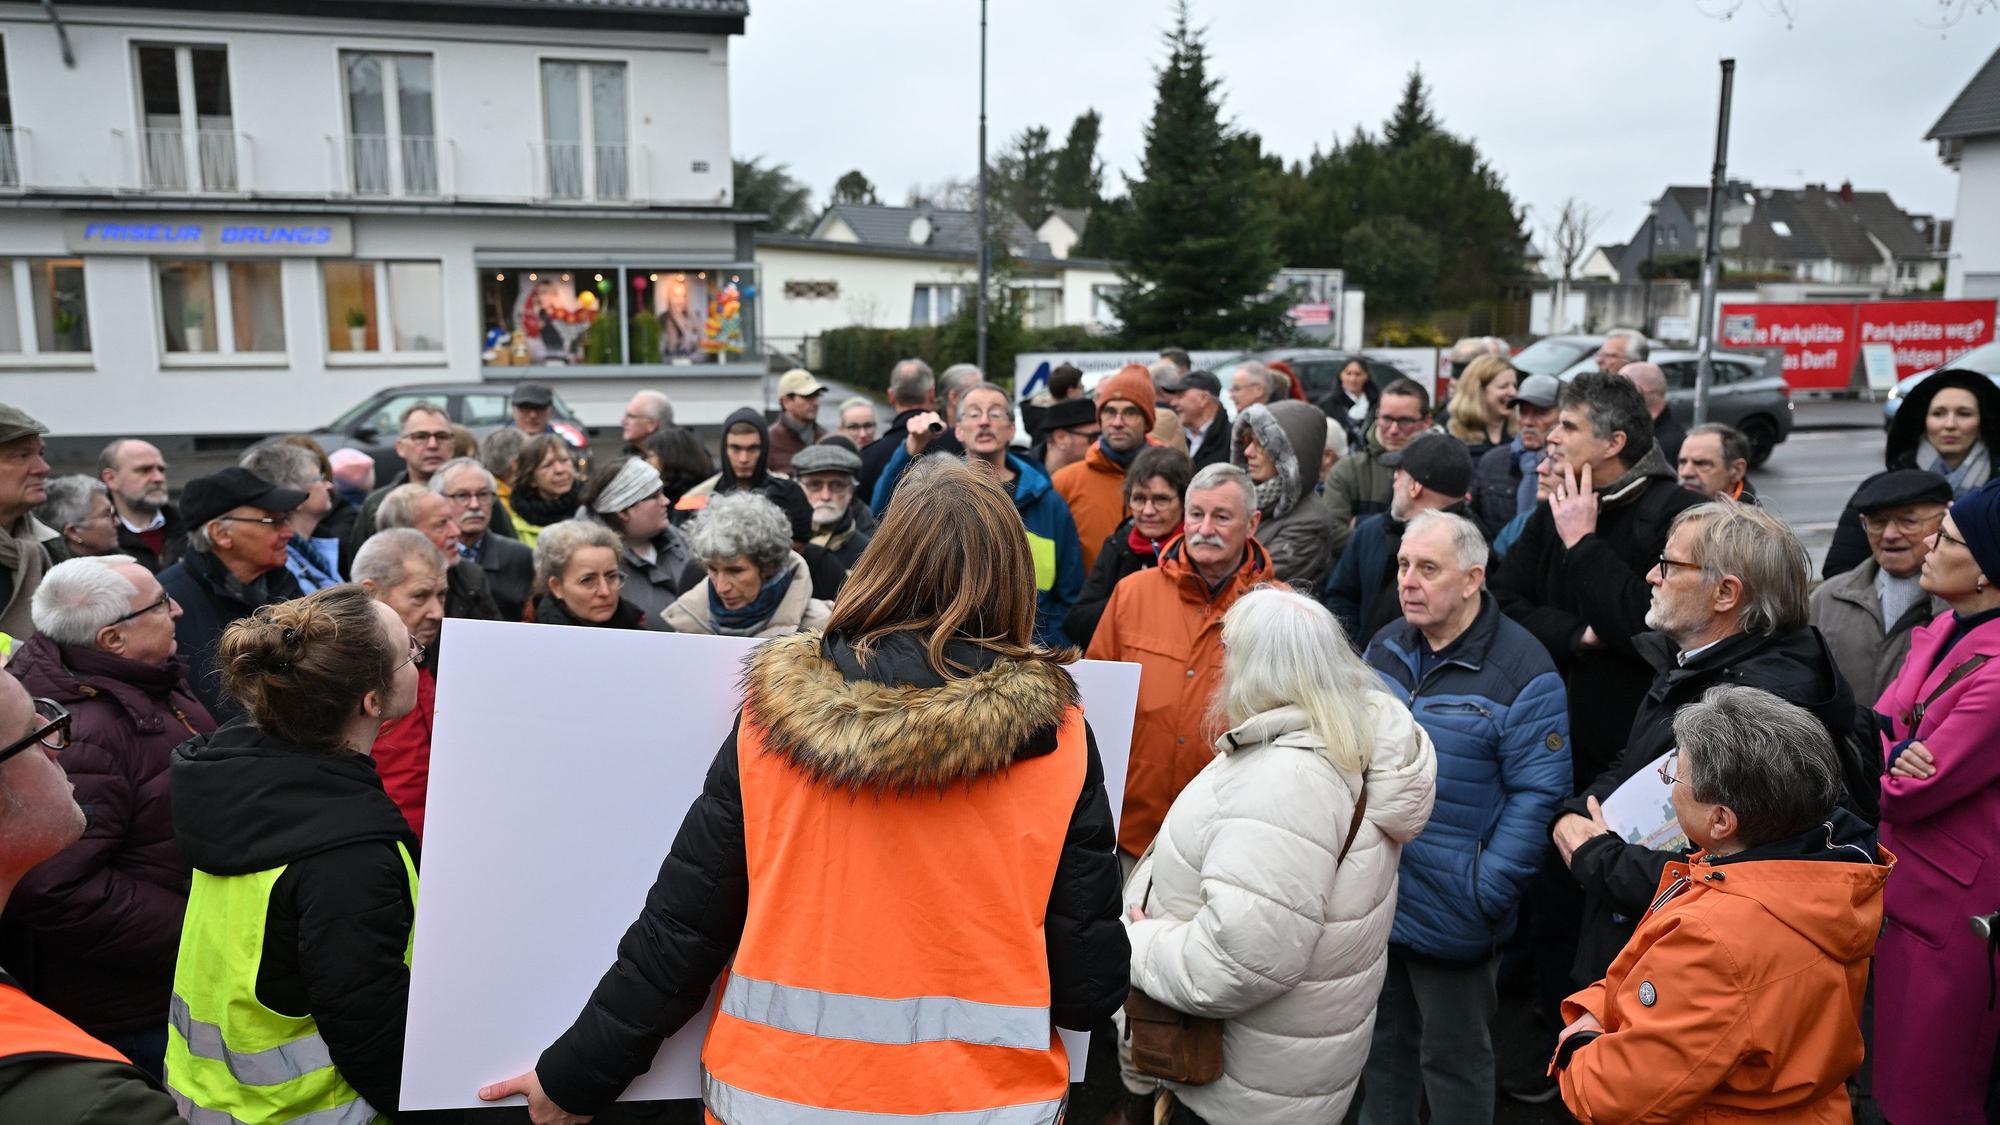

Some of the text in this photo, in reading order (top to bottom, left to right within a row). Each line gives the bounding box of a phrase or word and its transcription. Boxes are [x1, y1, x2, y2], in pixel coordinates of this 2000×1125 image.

[84, 223, 332, 244] FRISEUR BRUNGS
[1770, 323, 1845, 346] Parkplätze
[1861, 319, 1985, 343] Parkplätze weg?
[1781, 354, 1799, 370] as
